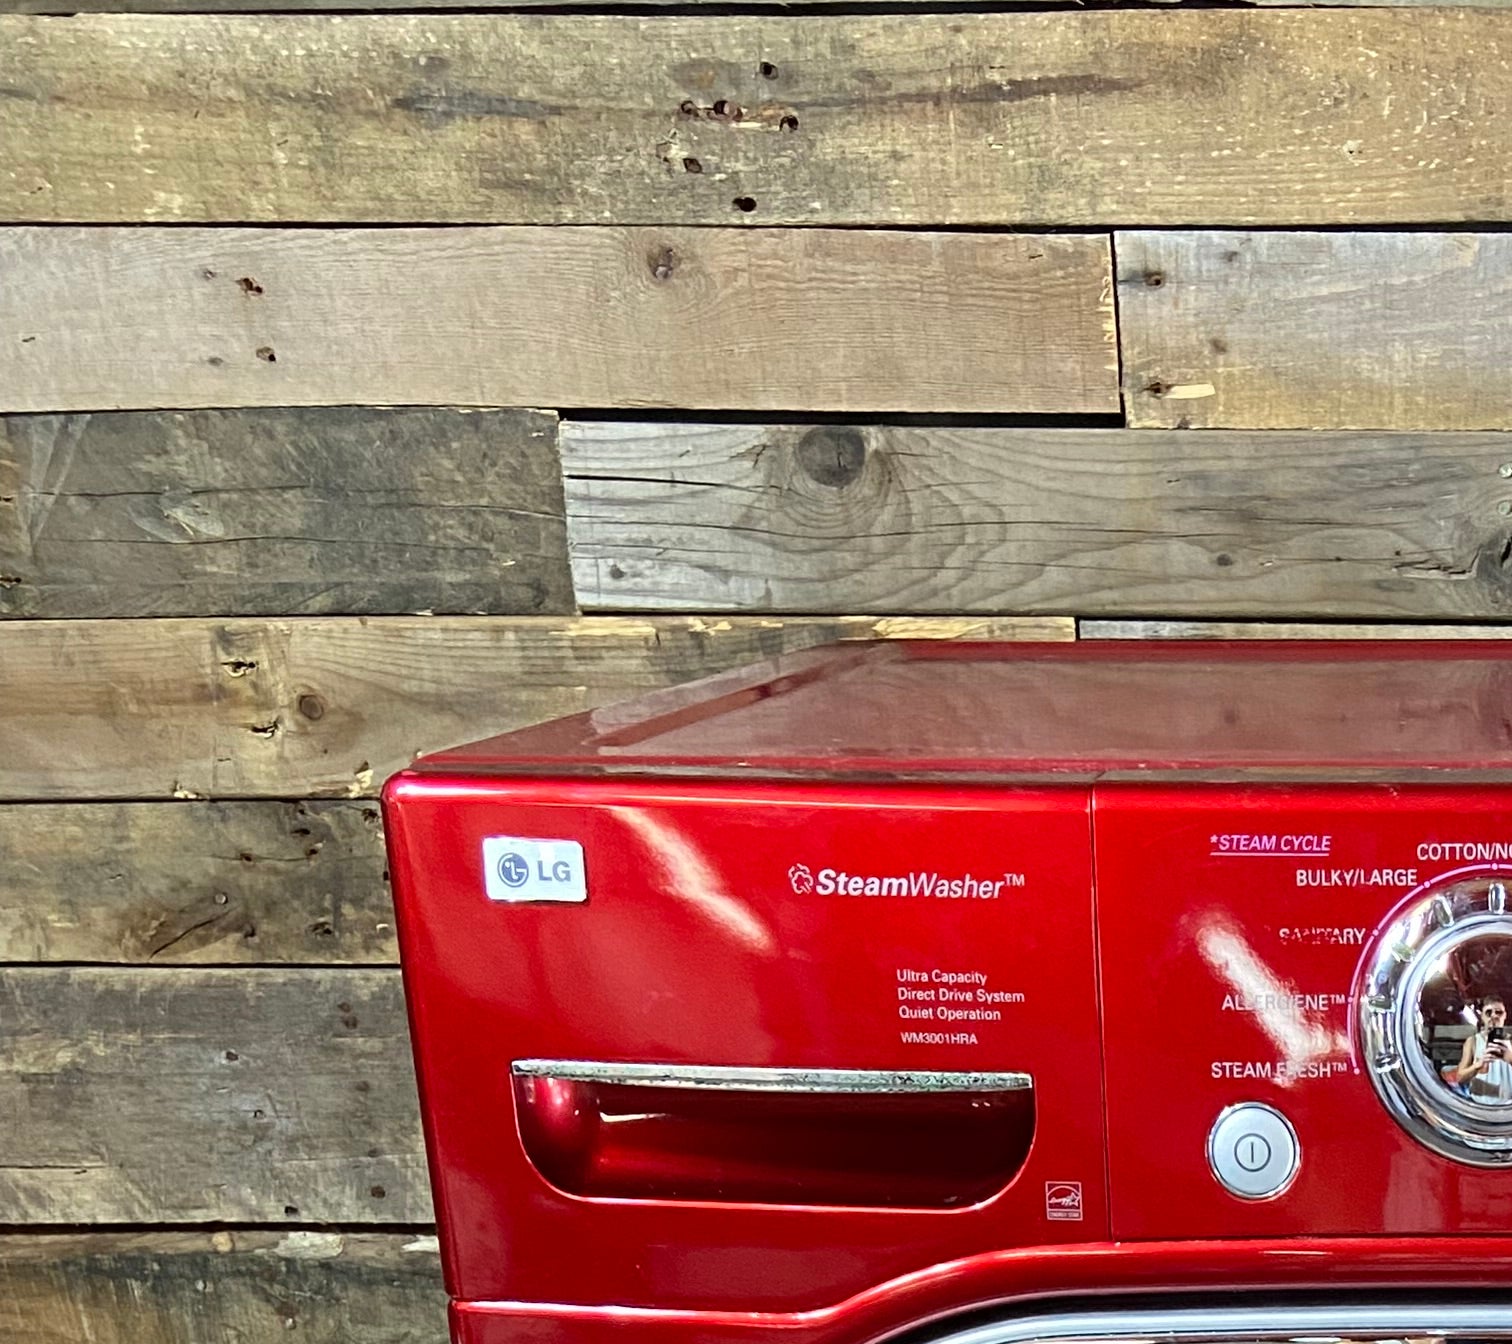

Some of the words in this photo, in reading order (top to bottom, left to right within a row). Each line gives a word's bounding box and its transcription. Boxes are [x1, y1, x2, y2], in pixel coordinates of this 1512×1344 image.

[1280, 835, 1332, 852] CYCLE
[537, 860, 571, 882] LG
[1296, 868, 1418, 887] BULKY/LARGE
[896, 968, 929, 982] Ultra
[931, 969, 988, 986] Capacity
[897, 987, 936, 1001] Direct
[938, 987, 974, 1002] Drive
[976, 988, 1026, 1005] System
[898, 1005, 935, 1020] Quiet
[936, 1006, 1002, 1022] Operation
[900, 1031, 979, 1045] WM3001HRA
[1211, 1062, 1272, 1079] STEAM
[1275, 1062, 1348, 1079] FESH™
